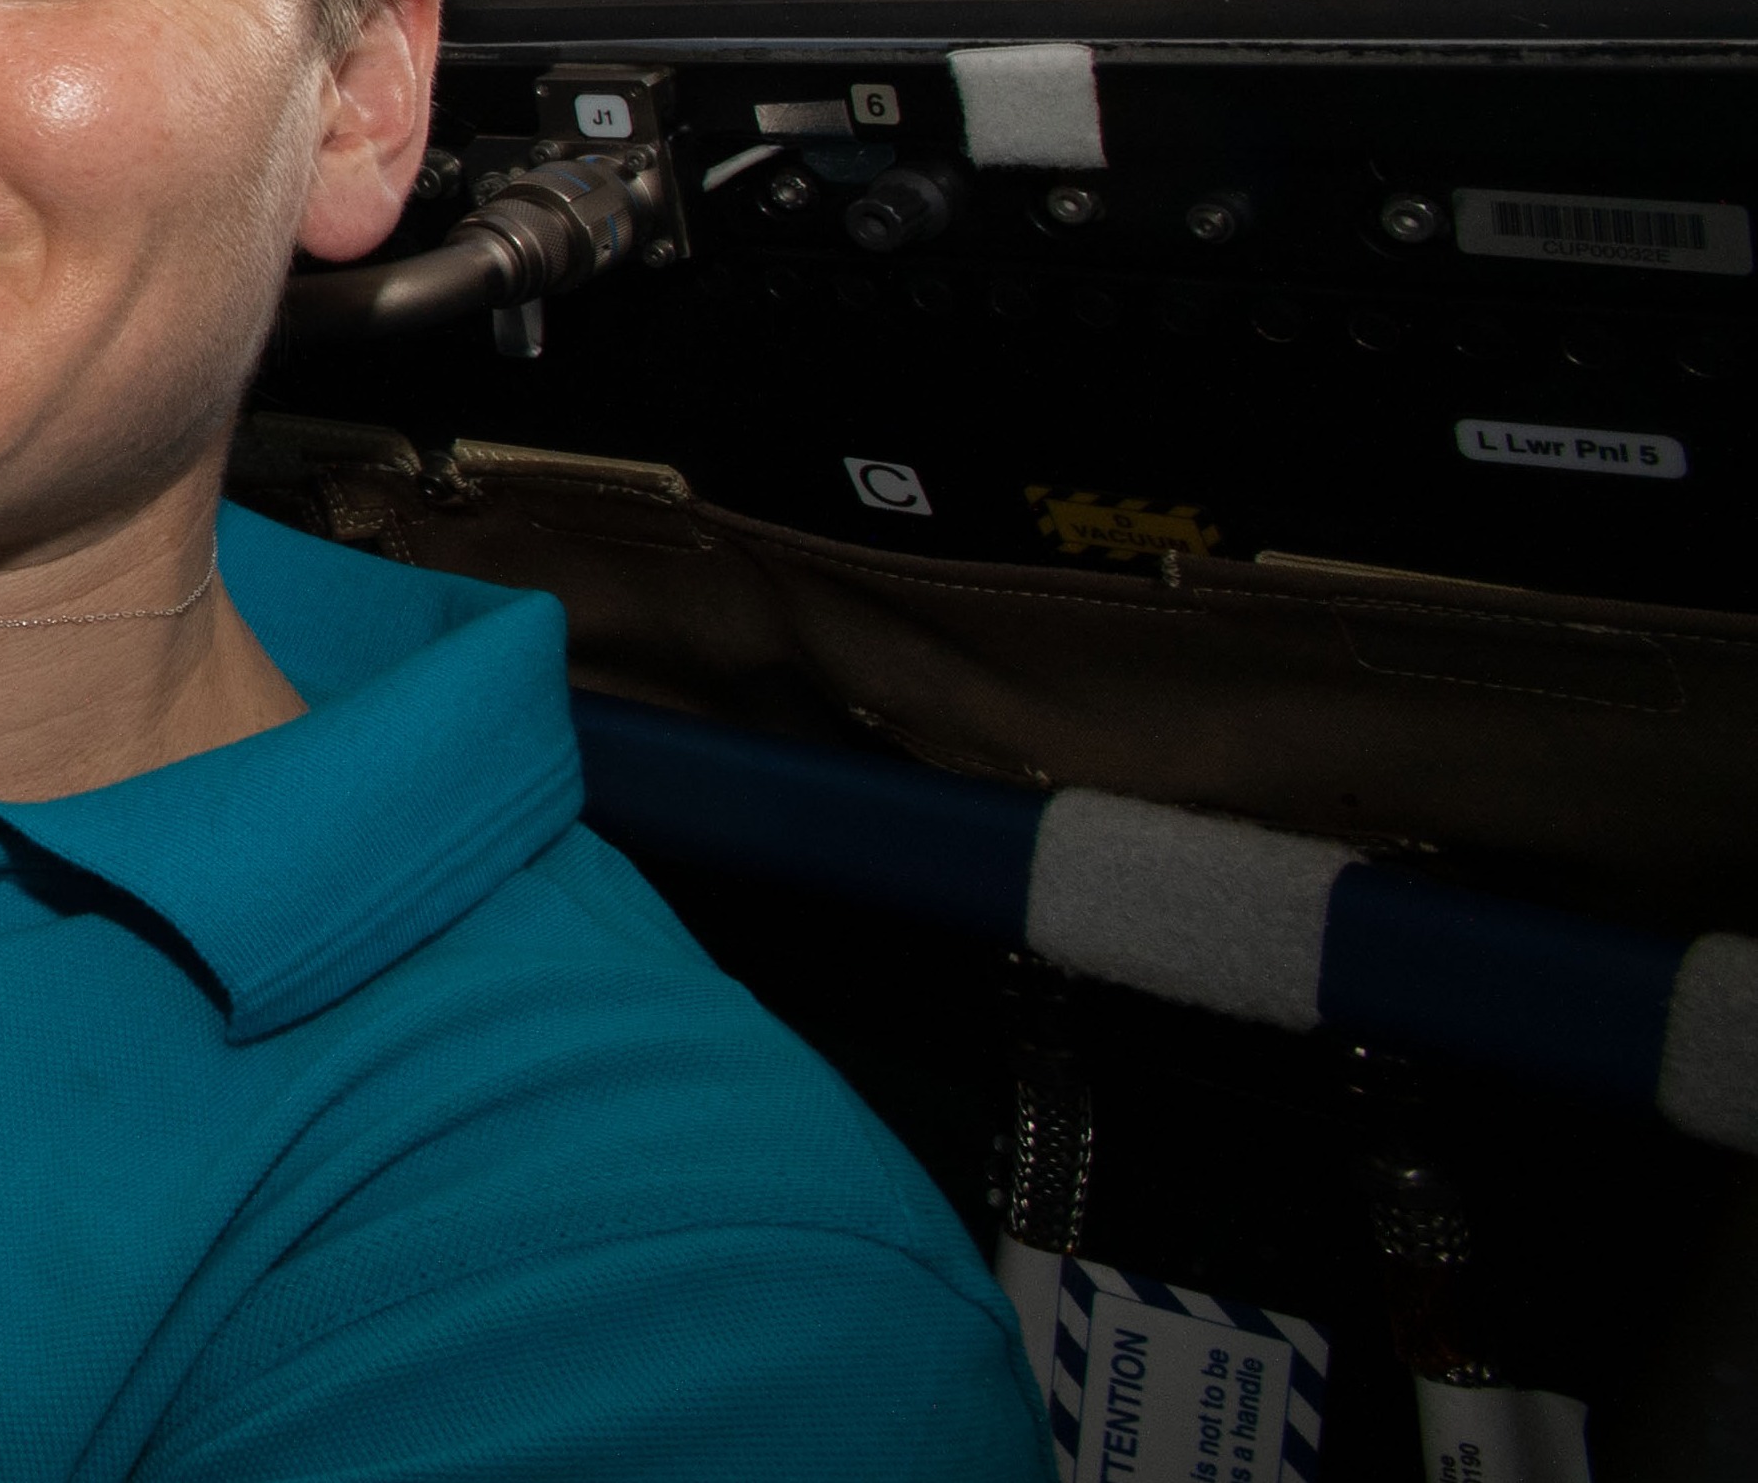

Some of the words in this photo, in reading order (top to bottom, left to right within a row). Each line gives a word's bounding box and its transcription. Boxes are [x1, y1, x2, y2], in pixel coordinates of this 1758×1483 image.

[593, 110, 613, 125] J1
[867, 93, 885, 117] 6
[1542, 240, 1671, 264] CUP00032E
[1477, 431, 1497, 450] L
[1505, 433, 1566, 456] Lwr
[1574, 439, 1630, 463] Pnl
[1639, 445, 1660, 465] 5
[860, 464, 917, 508] C
[1206, 1347, 1230, 1379] be
[1200, 1382, 1225, 1409] to
[1238, 1356, 1265, 1441] handle
[1197, 1411, 1223, 1455] not
[1235, 1448, 1253, 1464] a
